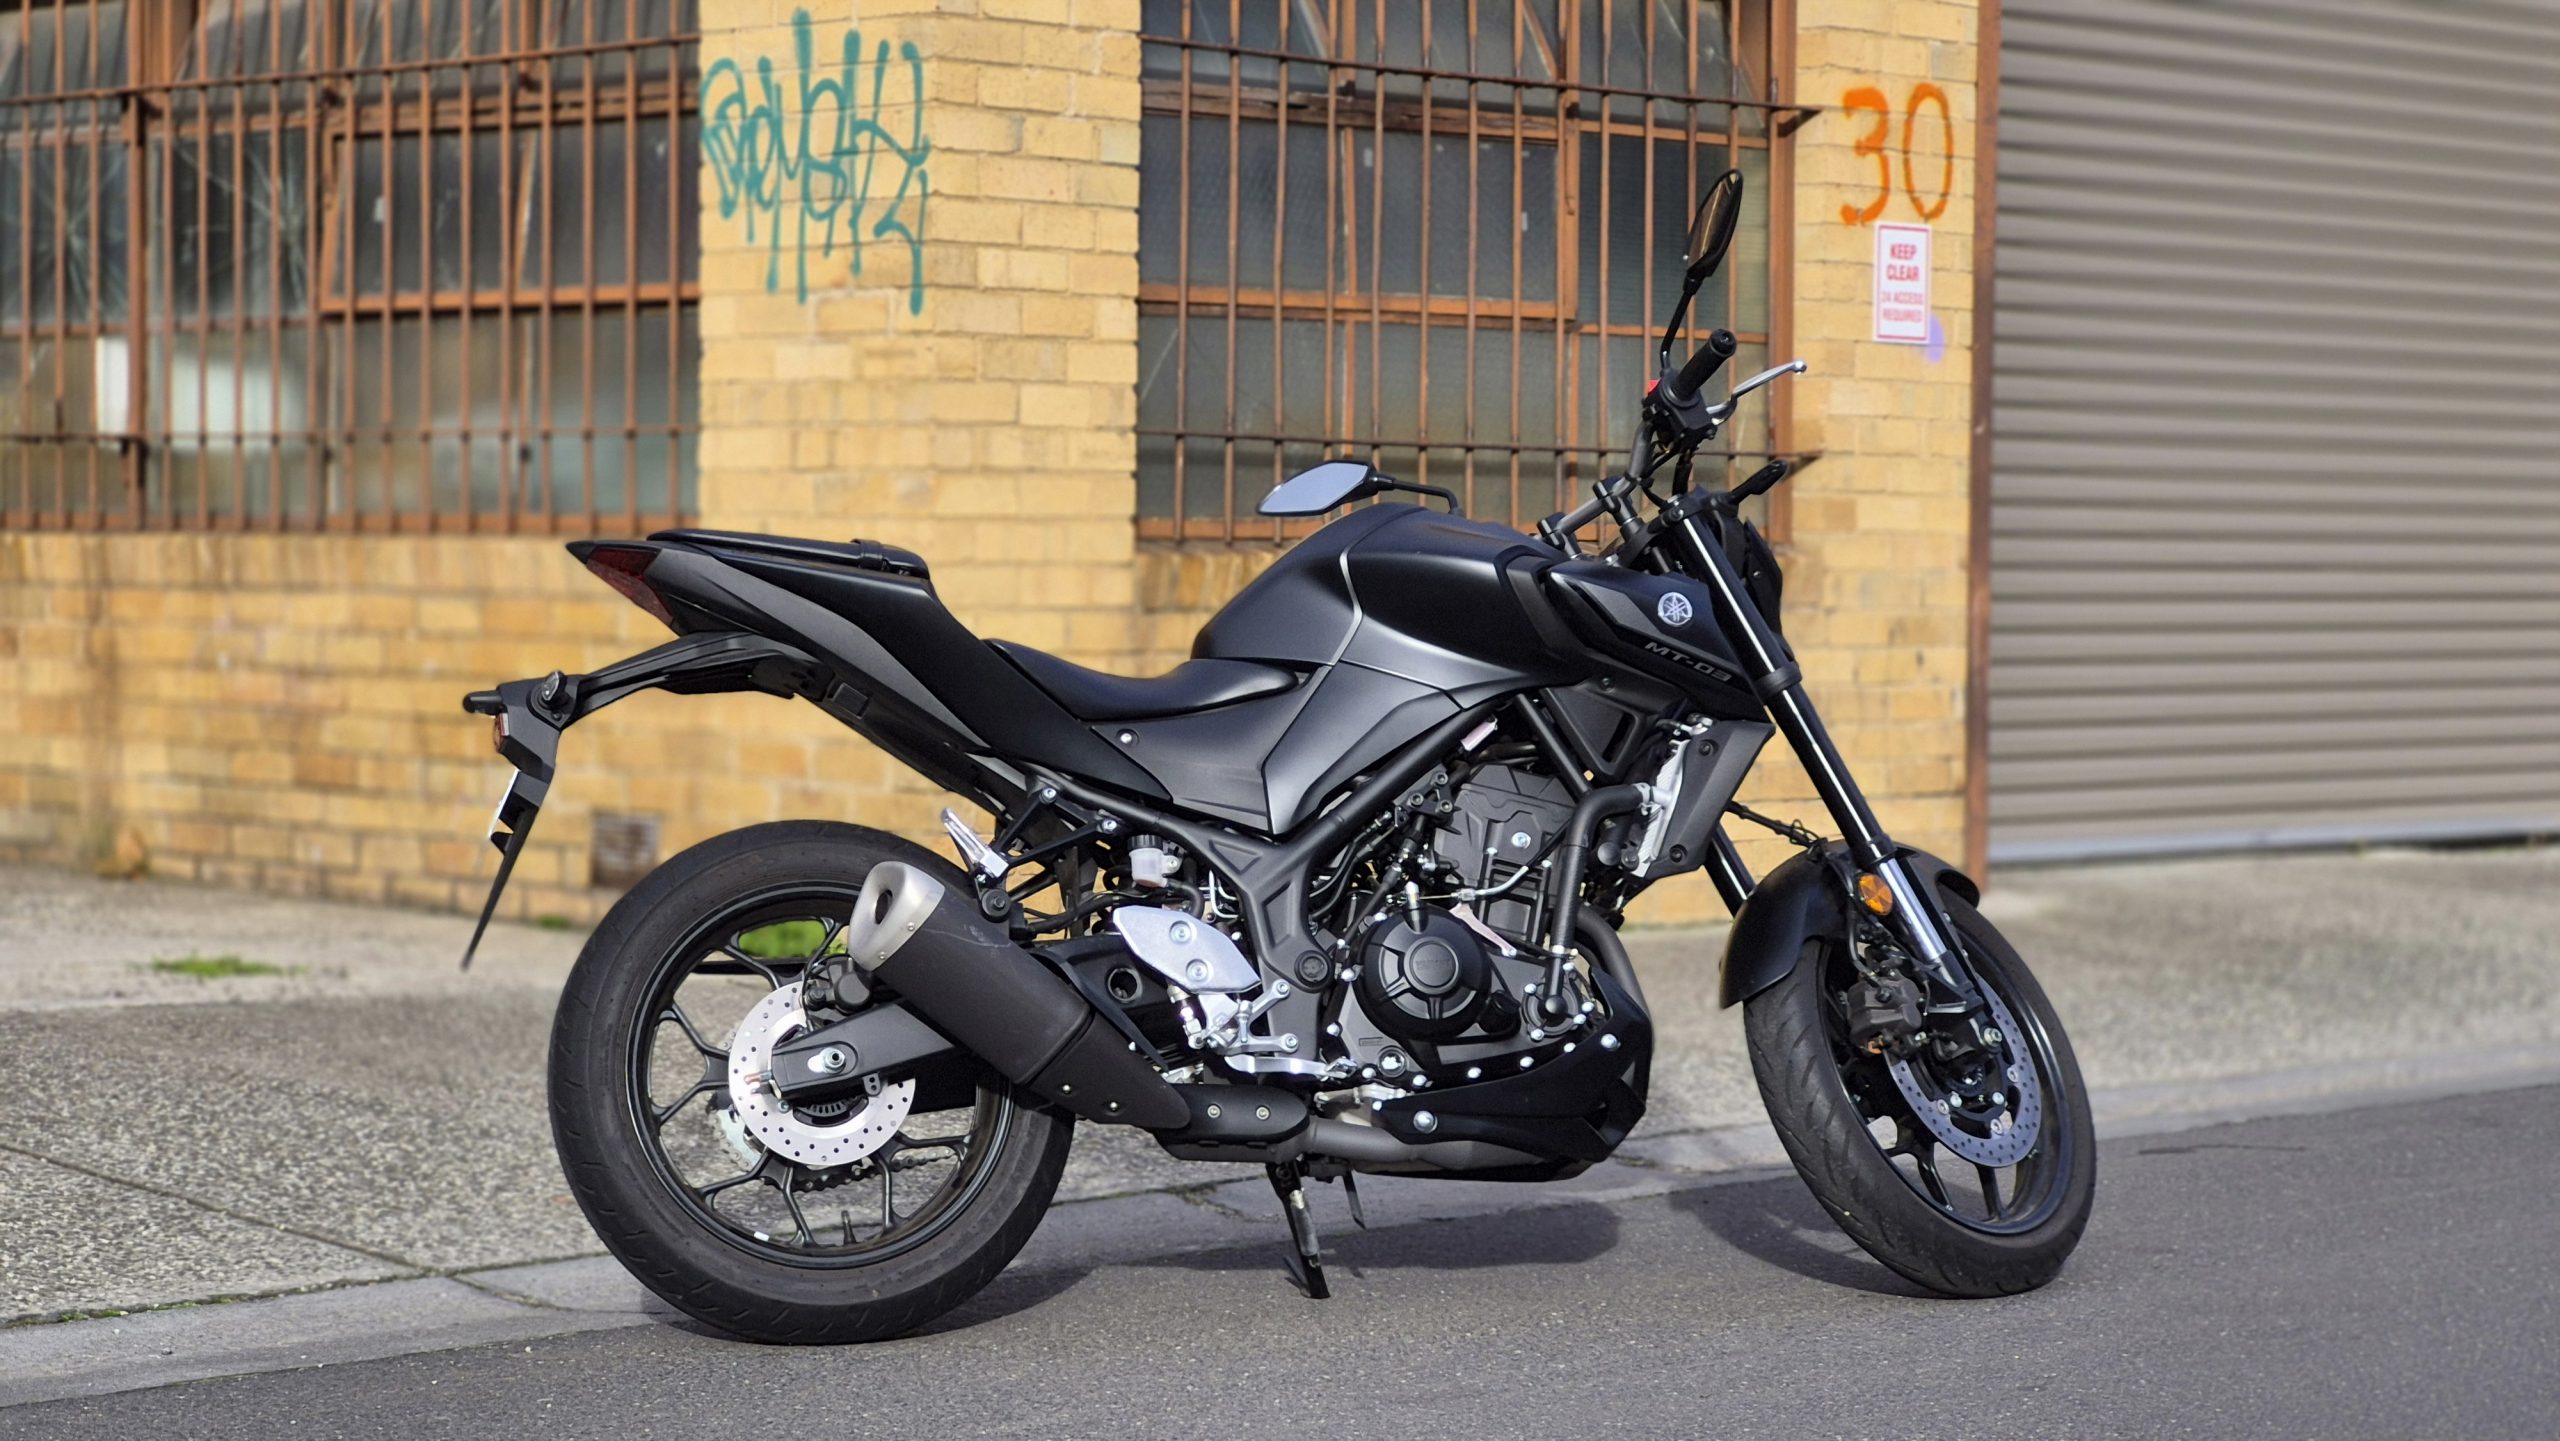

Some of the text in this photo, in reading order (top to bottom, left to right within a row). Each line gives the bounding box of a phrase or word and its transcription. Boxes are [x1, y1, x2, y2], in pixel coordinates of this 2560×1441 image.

[1840, 82, 1953, 226] 30
[1890, 243, 1917, 260] KEEP
[1886, 264, 1919, 282] CLEAR
[1645, 641, 1733, 682] MT-03
